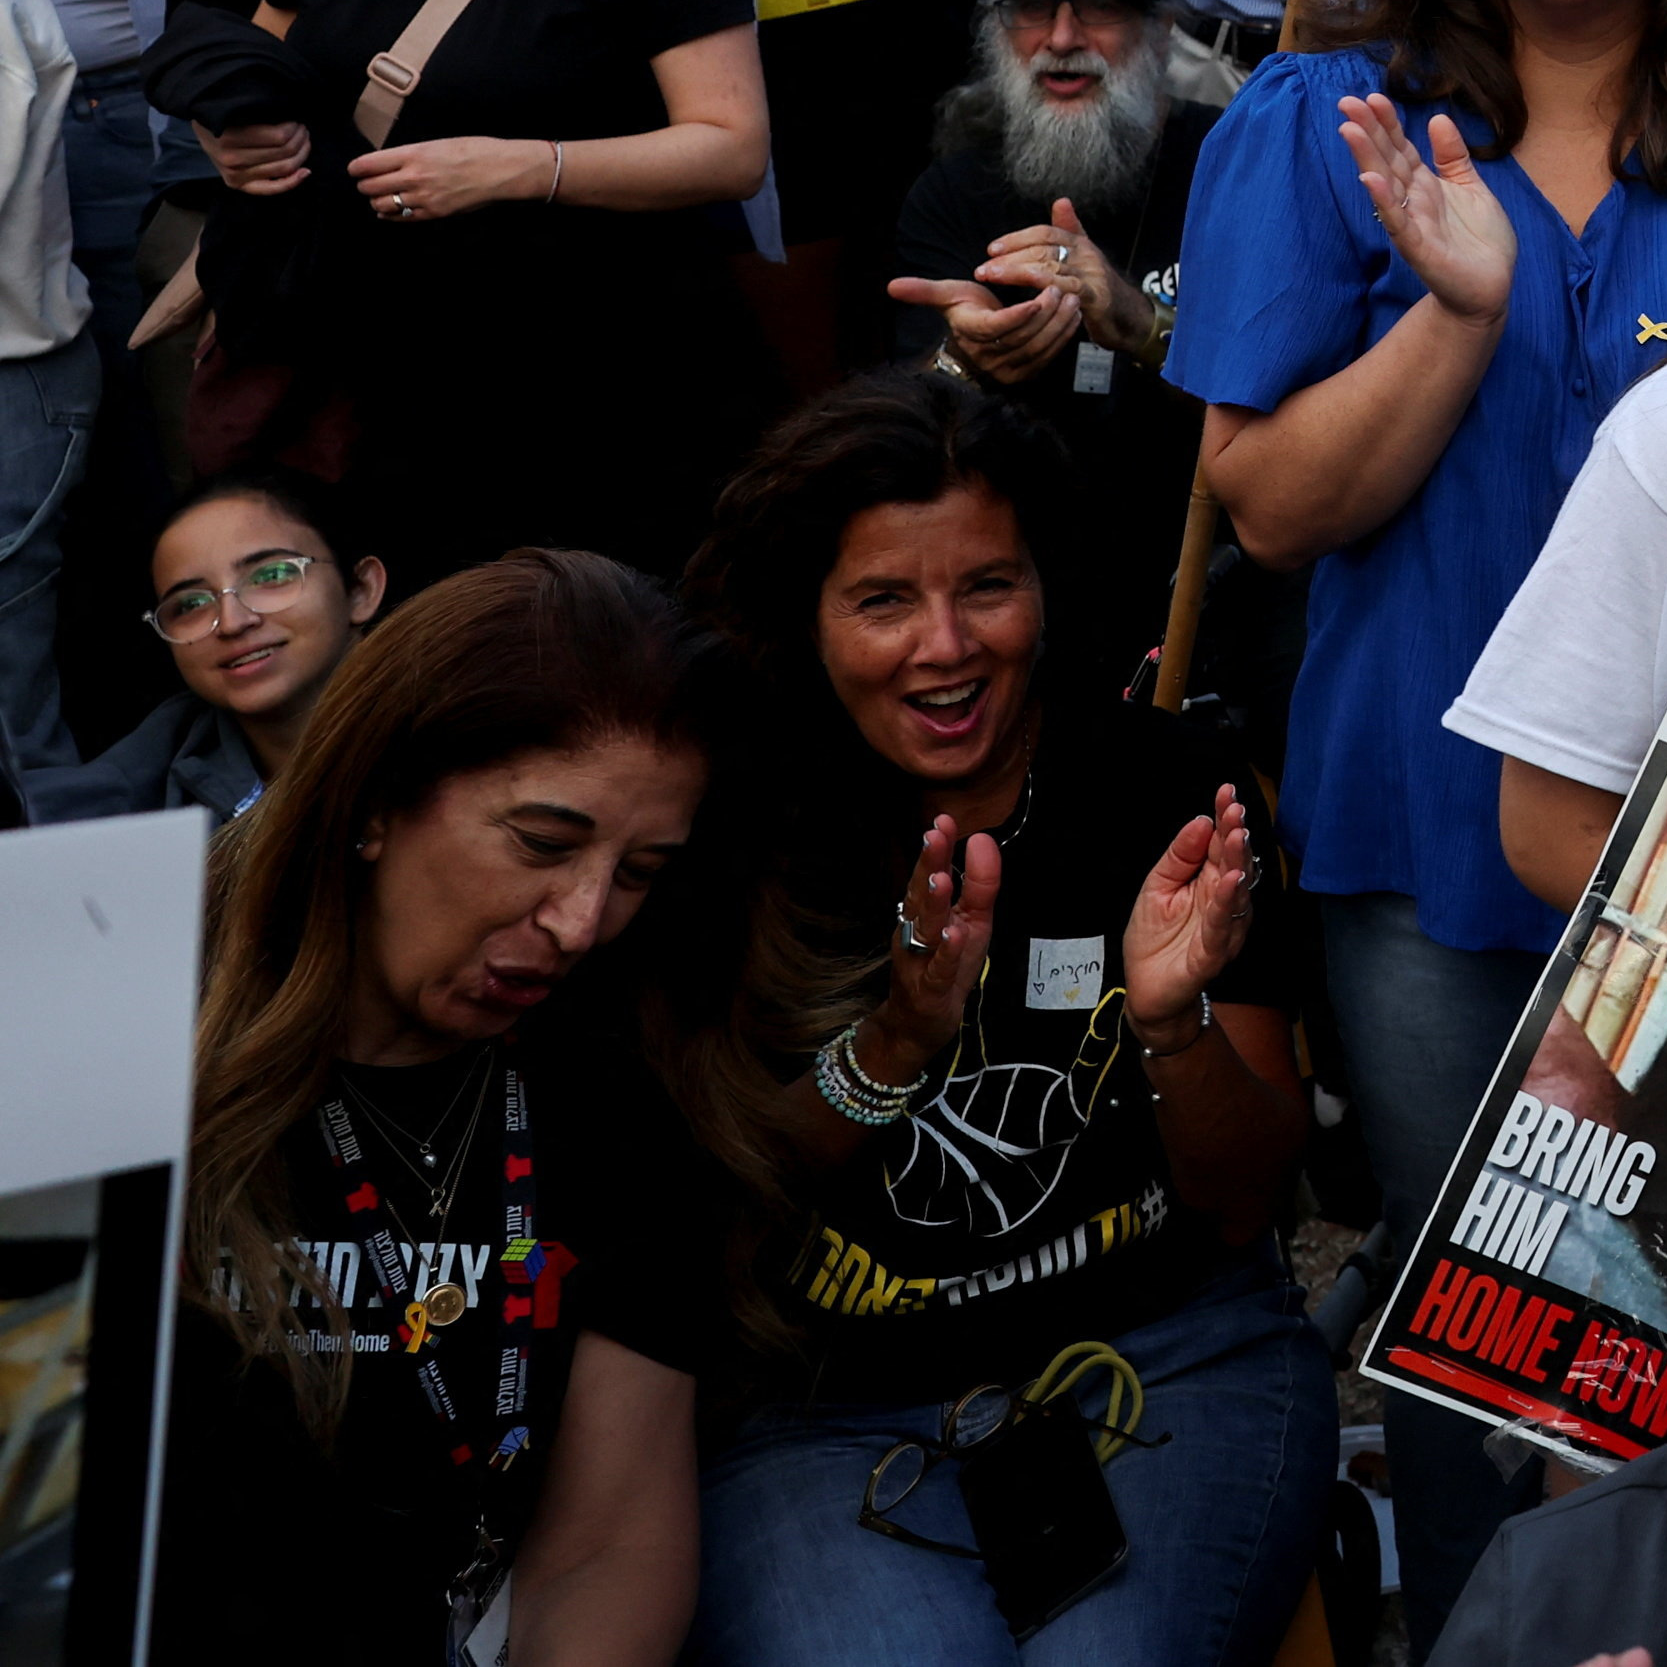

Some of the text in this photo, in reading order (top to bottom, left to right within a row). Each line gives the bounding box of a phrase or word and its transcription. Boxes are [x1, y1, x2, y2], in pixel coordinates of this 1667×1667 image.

[1486, 1089, 1657, 1218] BRING
[1449, 1170, 1570, 1278] HIM
[1409, 1258, 1576, 1393] HOME
